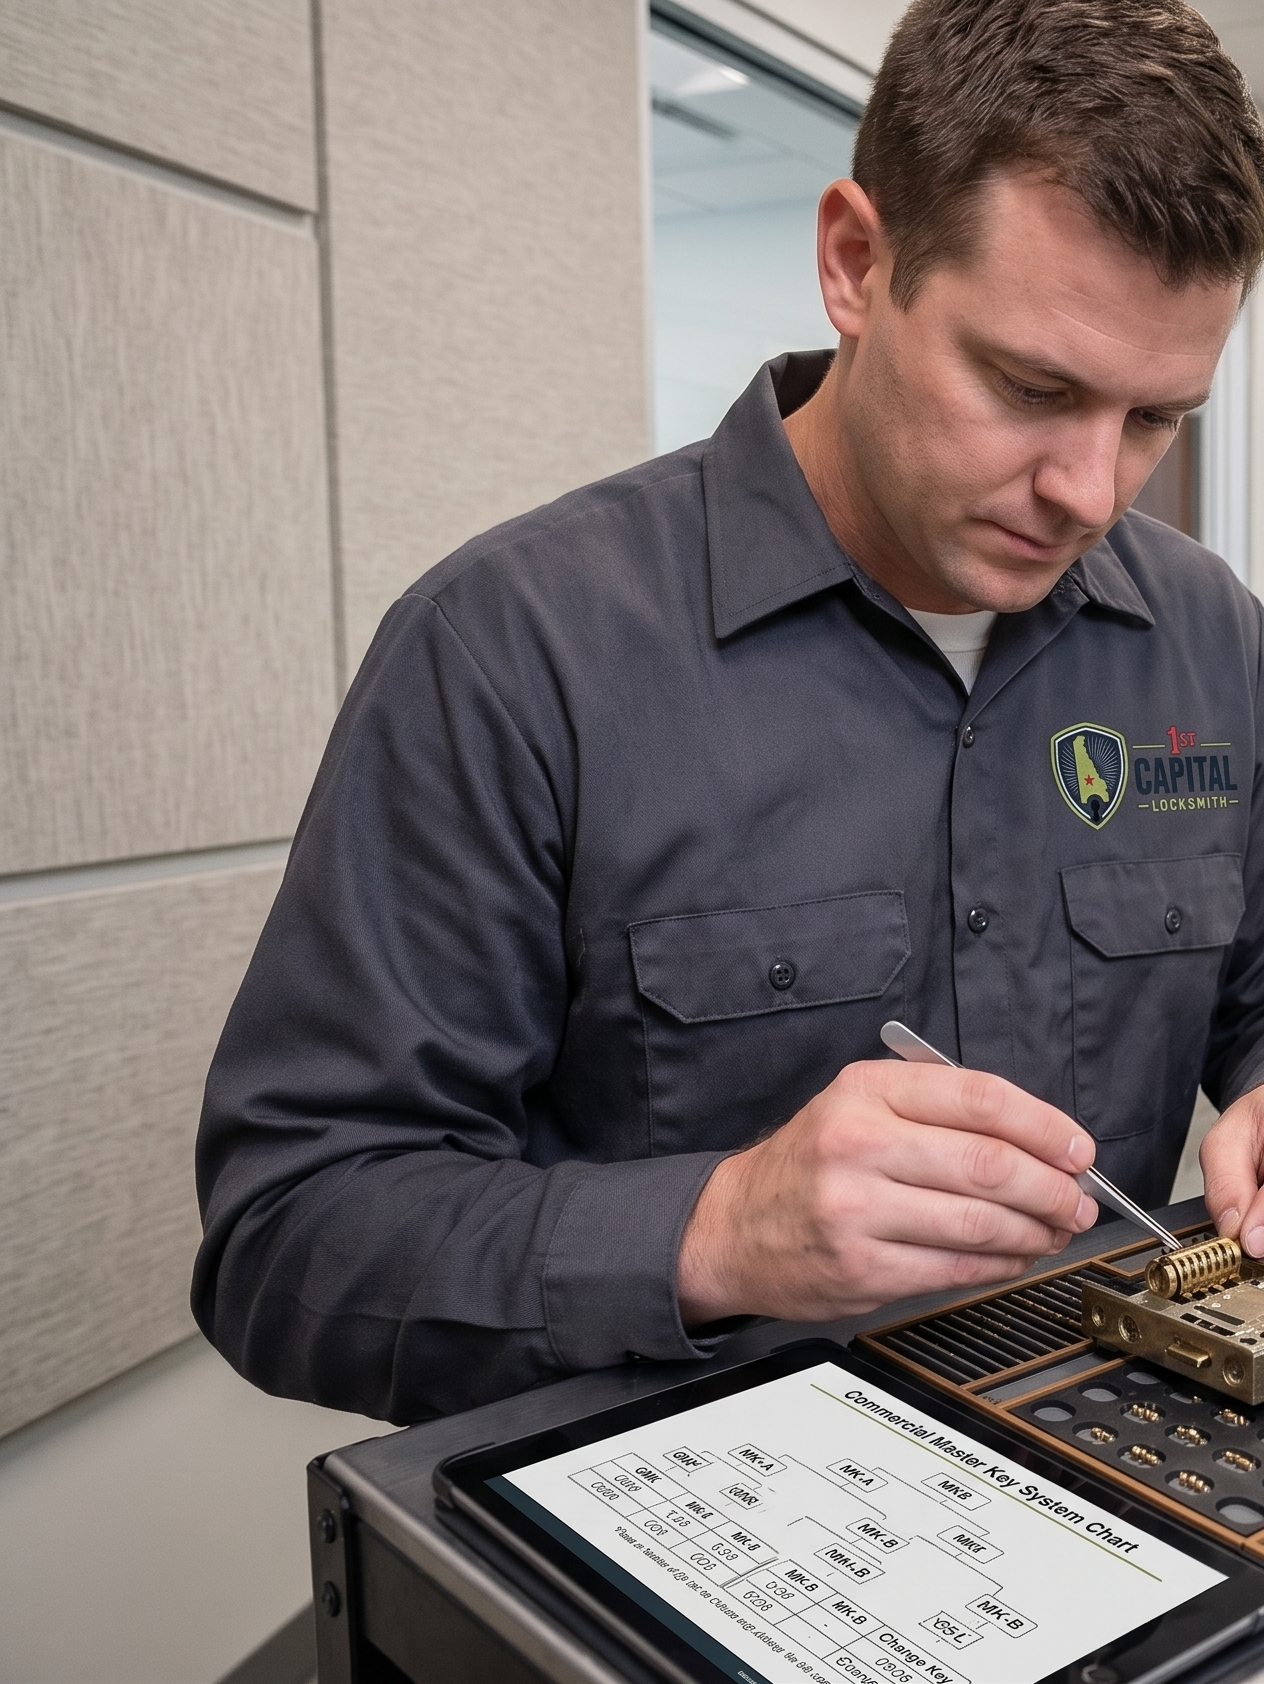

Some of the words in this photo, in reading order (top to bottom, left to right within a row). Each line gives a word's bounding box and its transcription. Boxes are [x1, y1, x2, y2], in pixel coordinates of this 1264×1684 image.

[1166, 725, 1196, 755] 1ST
[1133, 755, 1238, 796] CAPITAL
[1151, 796, 1228, 812] LOCKSMITH
[844, 1390, 935, 1441] Commercial
[929, 1435, 988, 1470] Master
[982, 1465, 1021, 1490] Key
[1018, 1484, 1086, 1526] System
[1085, 1521, 1140, 1555] Chart
